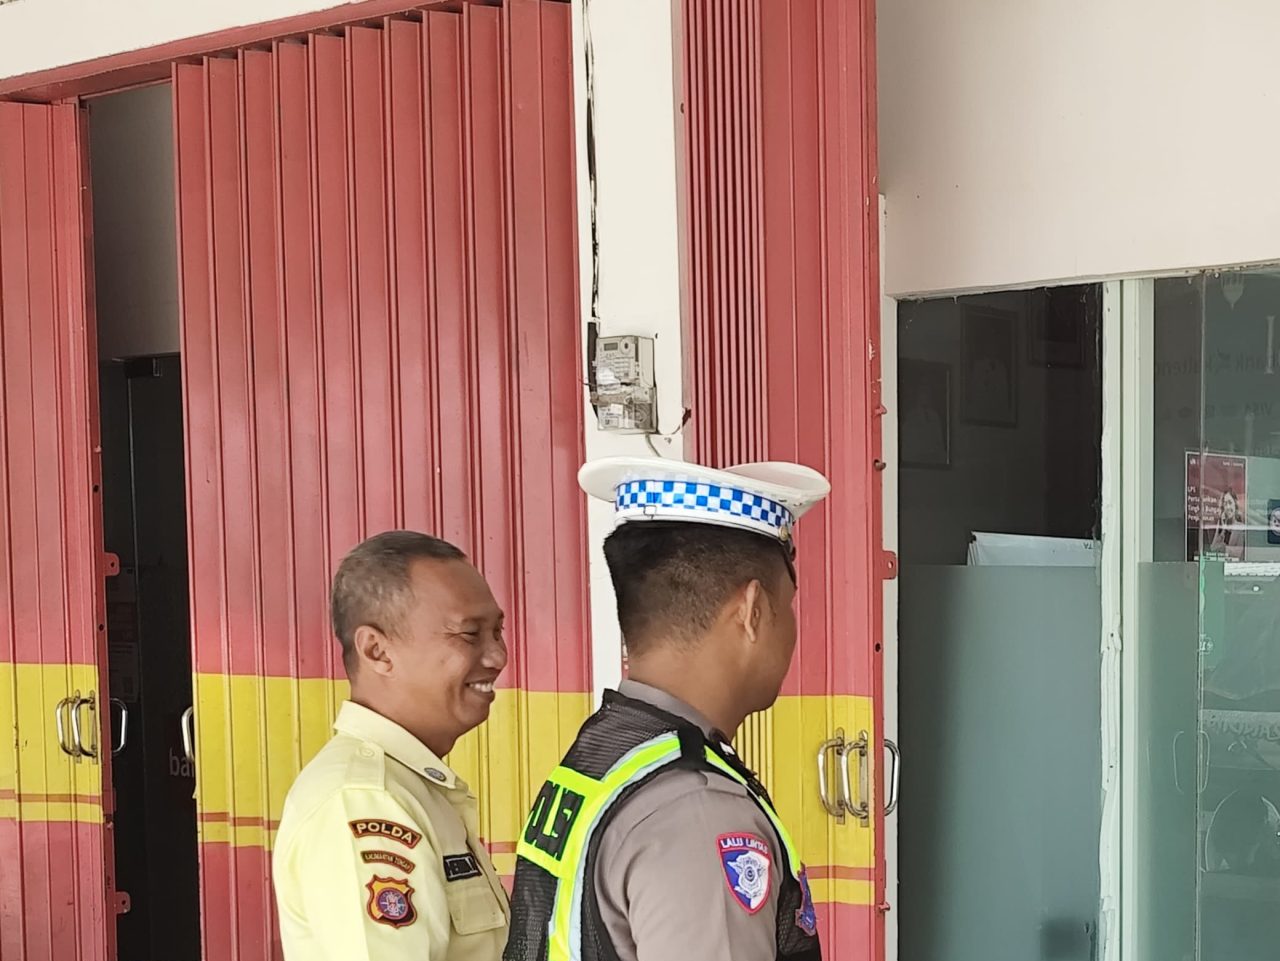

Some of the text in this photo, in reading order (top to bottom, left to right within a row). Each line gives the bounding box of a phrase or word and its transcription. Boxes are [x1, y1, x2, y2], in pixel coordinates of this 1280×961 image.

[170, 748, 194, 777] ba
[356, 822, 413, 844] POLDA
[720, 837, 744, 848] LALU
